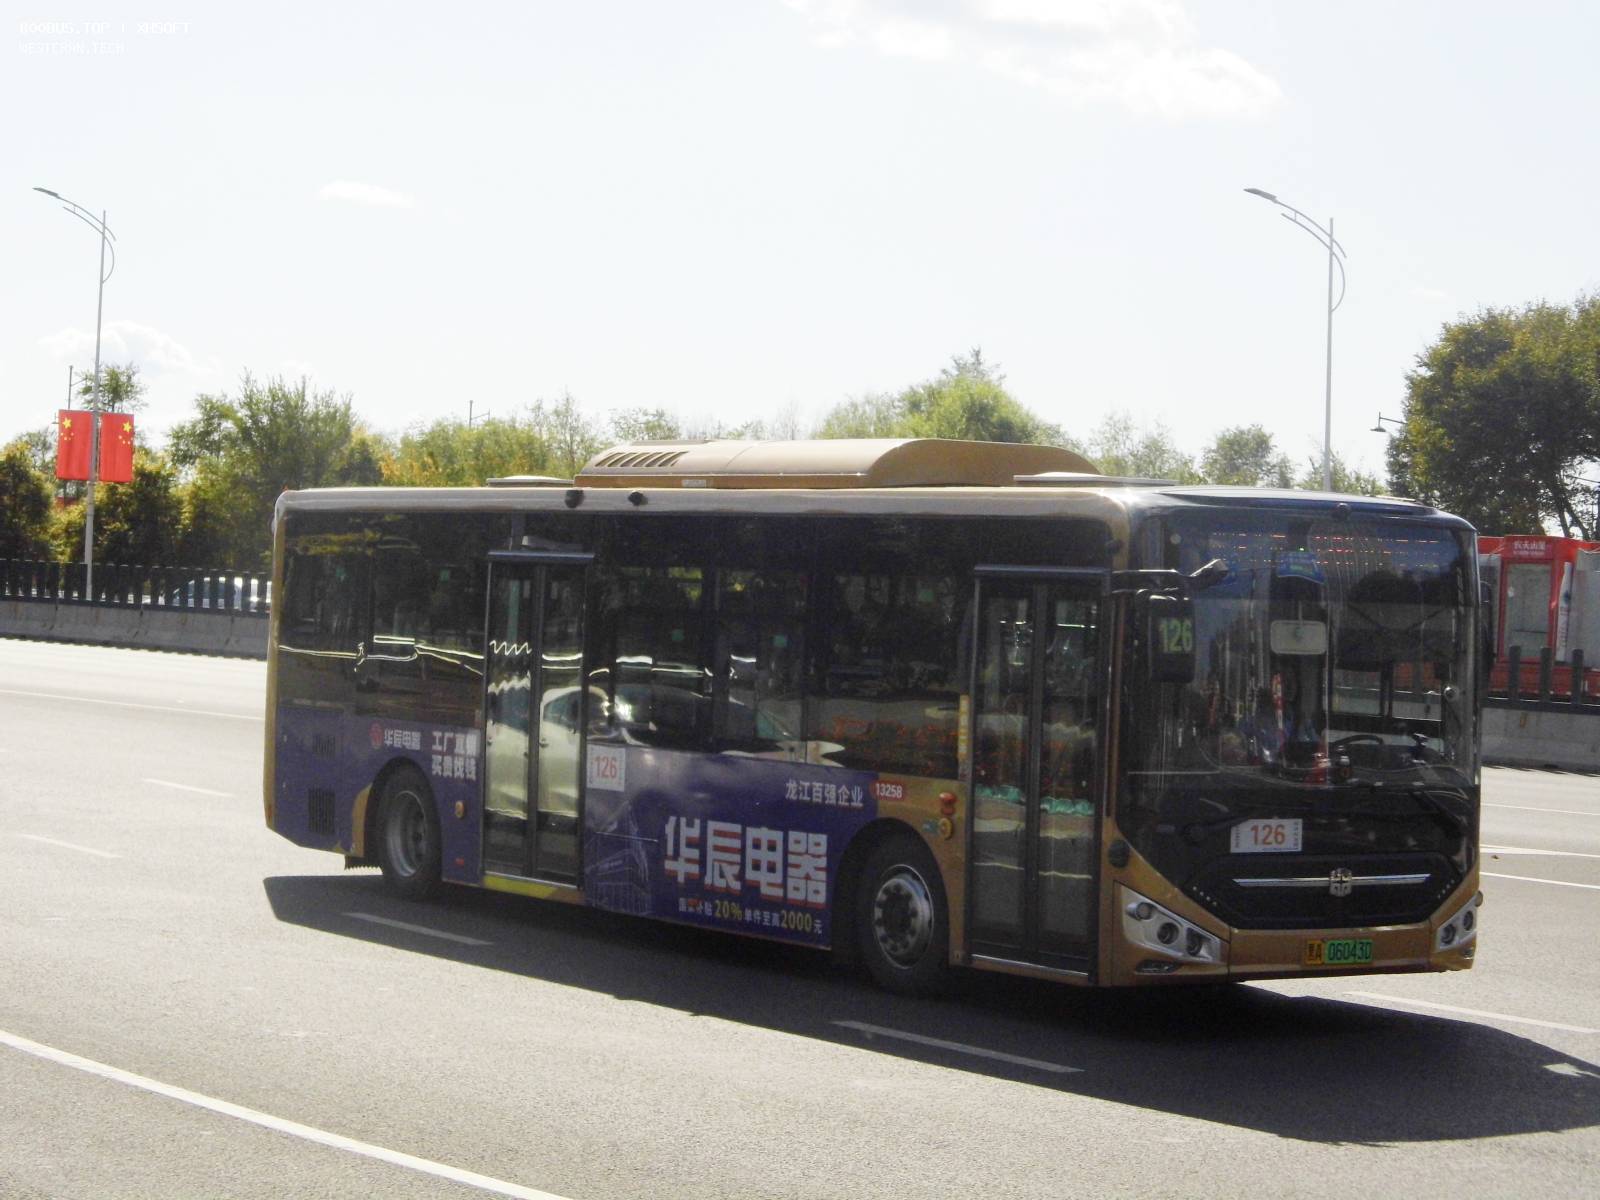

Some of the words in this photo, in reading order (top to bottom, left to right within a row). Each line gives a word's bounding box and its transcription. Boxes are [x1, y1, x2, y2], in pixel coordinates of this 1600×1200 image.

[1159, 617, 1193, 653] 126
[594, 757, 617, 779] 126
[785, 780, 863, 808] 龙江百强企业
[875, 783, 903, 799] 13258
[1250, 824, 1286, 845] 126
[664, 816, 828, 906] 华辰电器
